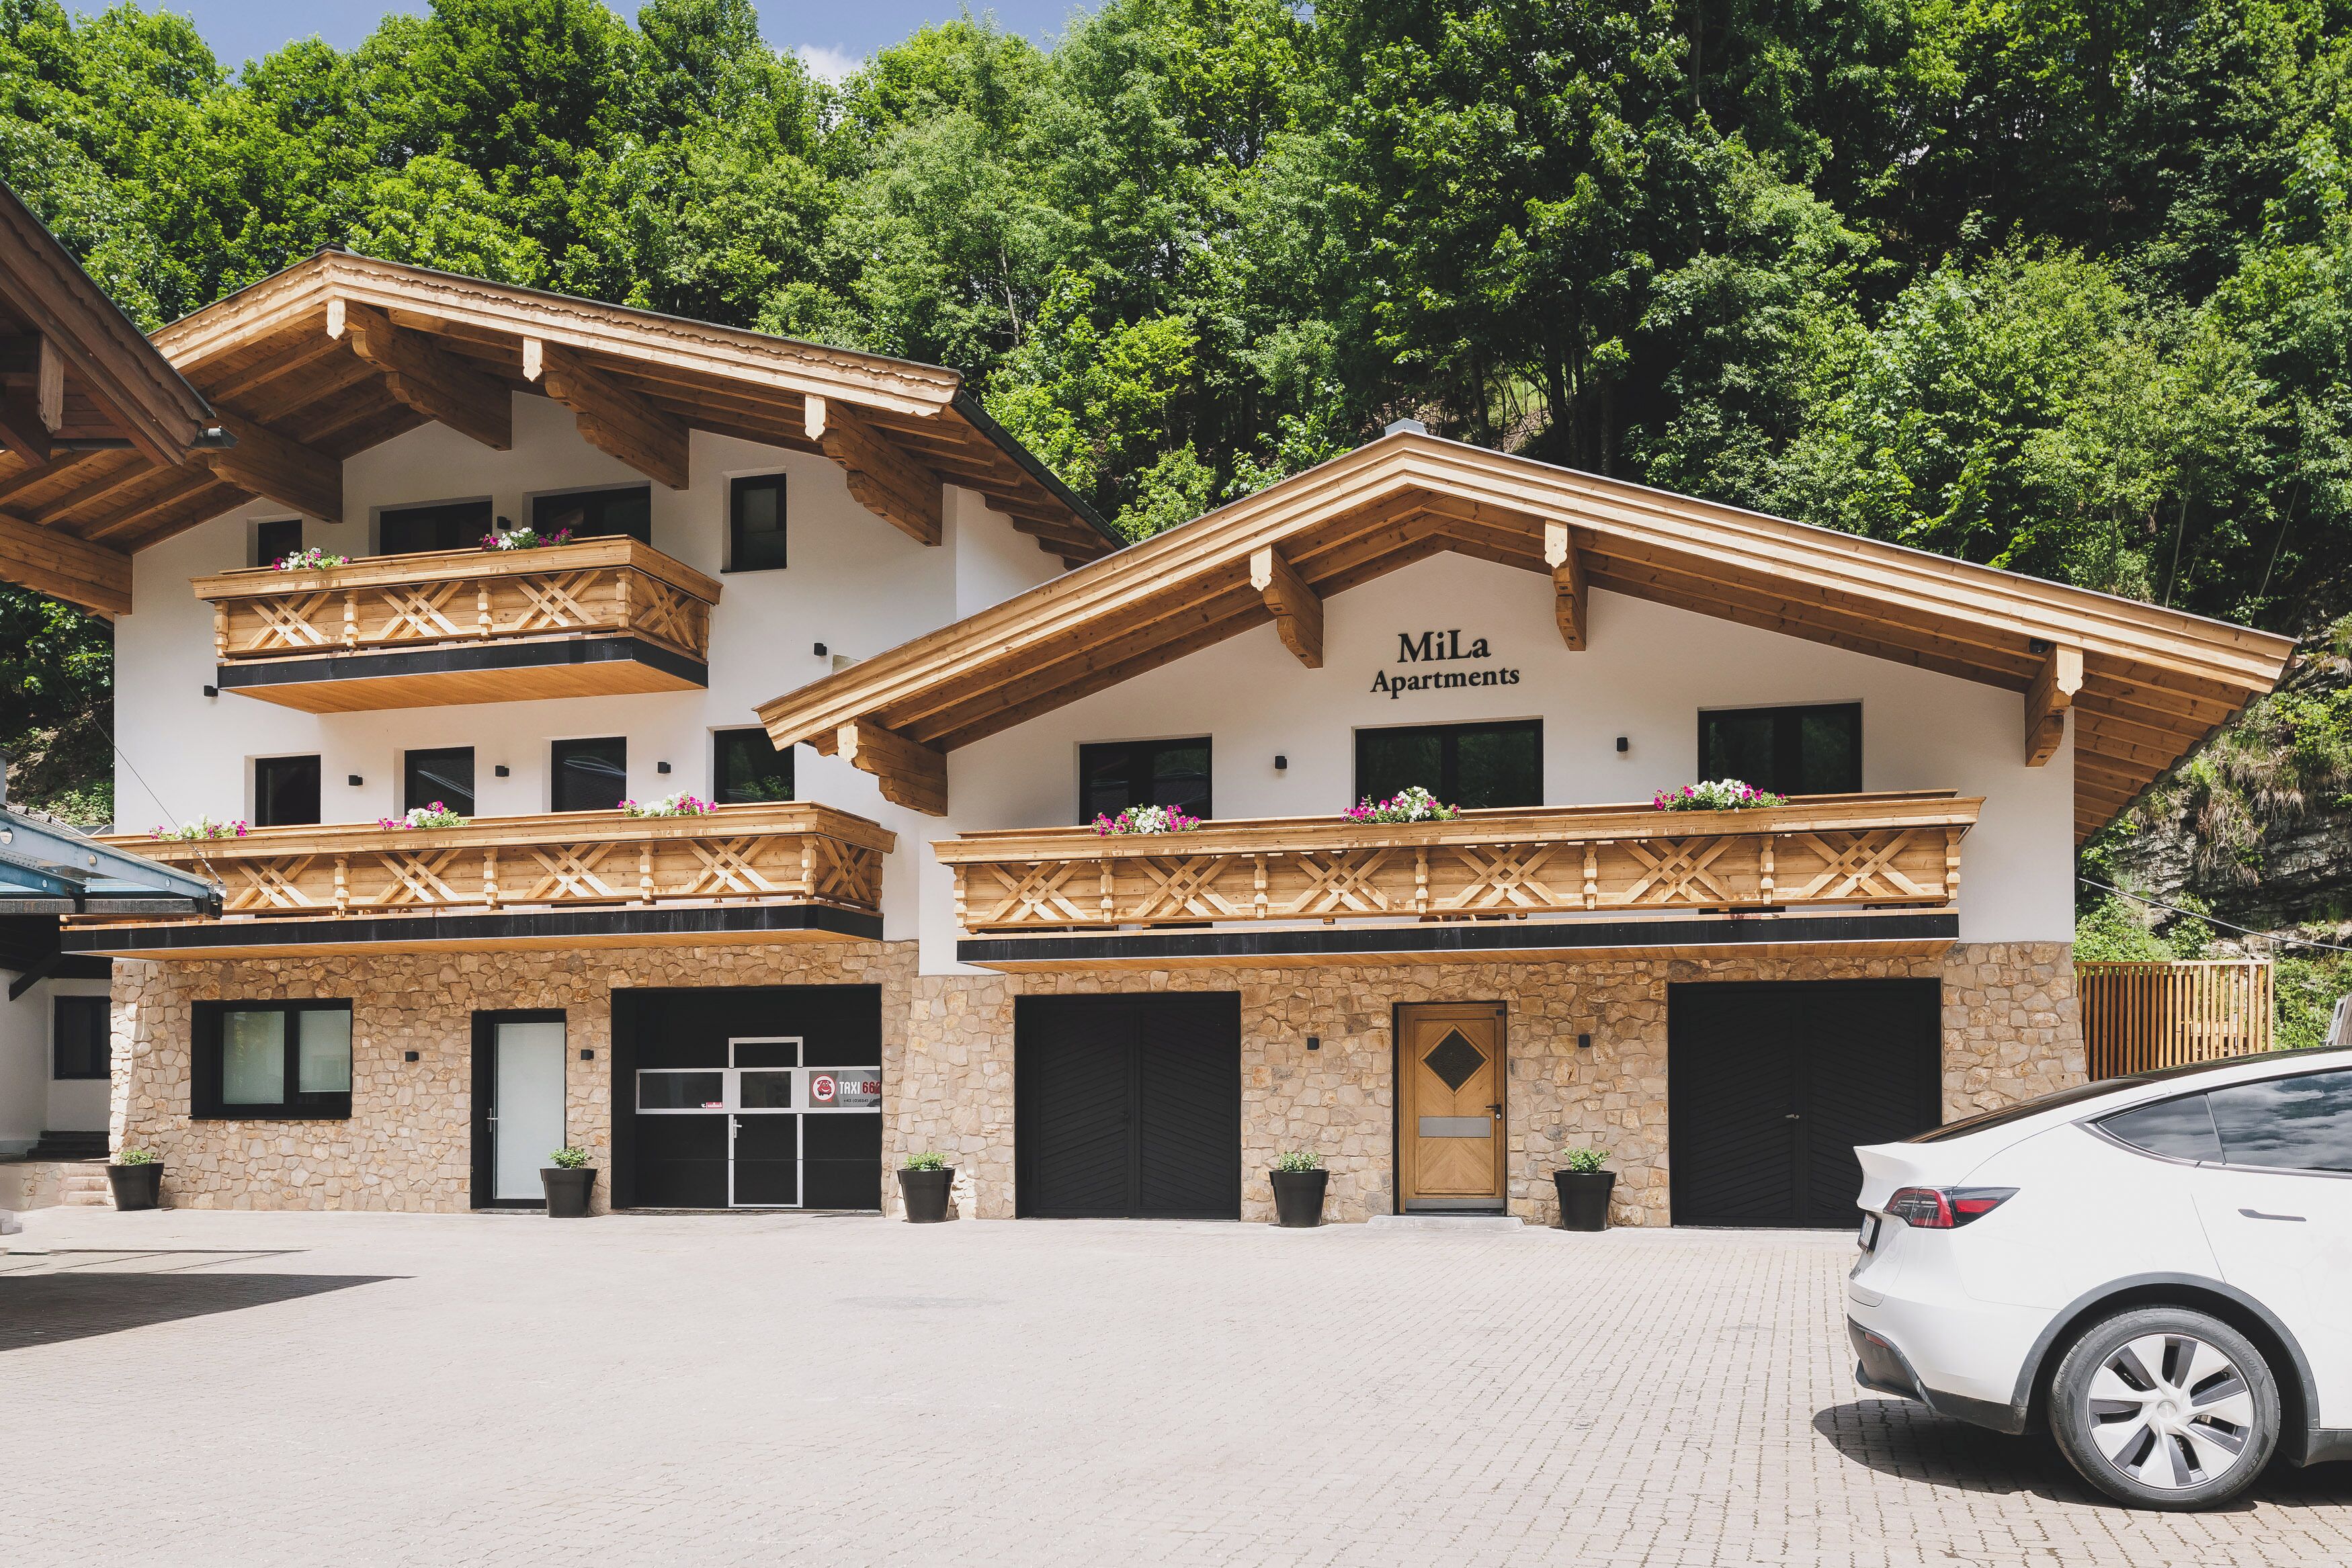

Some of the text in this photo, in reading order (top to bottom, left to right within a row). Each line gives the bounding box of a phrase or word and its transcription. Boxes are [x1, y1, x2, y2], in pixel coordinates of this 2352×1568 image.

[1397, 629, 1492, 663] MiLa
[1370, 667, 1520, 699] Apartments
[839, 1081, 860, 1094] TAXI
